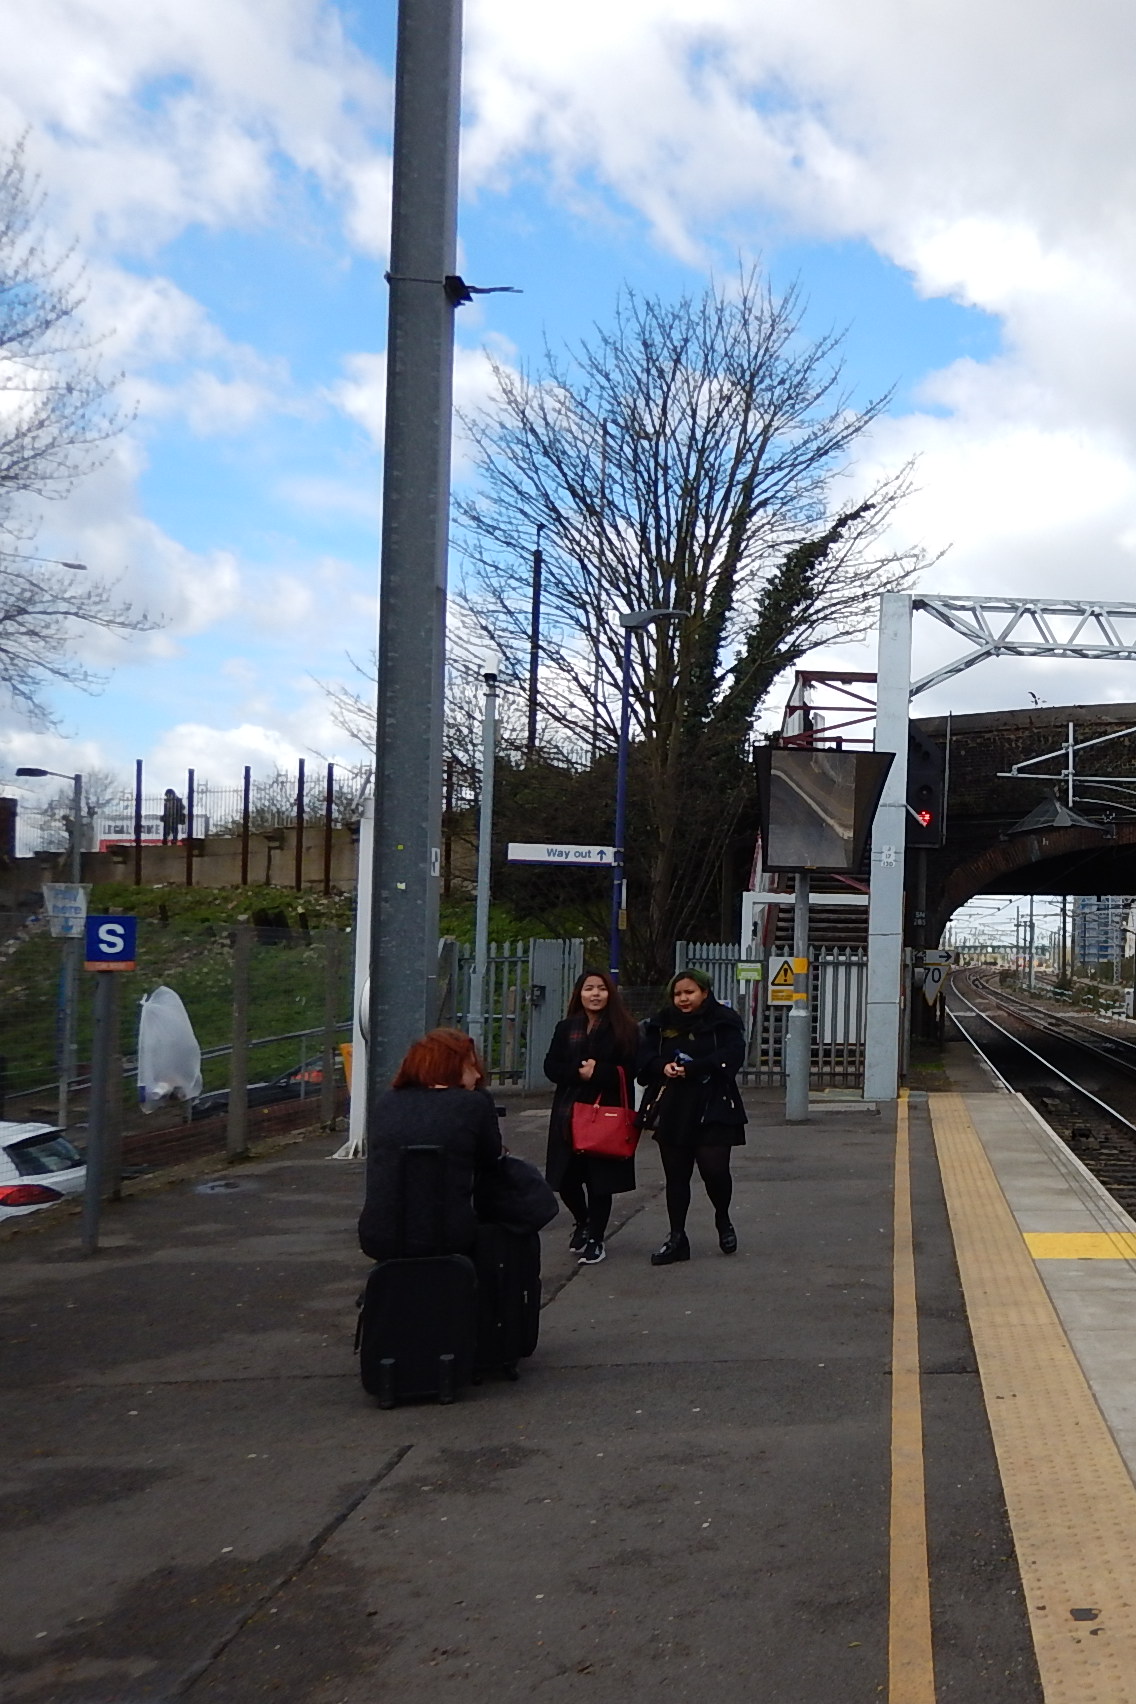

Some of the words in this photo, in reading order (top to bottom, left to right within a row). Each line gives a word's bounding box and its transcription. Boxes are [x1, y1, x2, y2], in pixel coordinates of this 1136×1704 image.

[546, 848, 570, 859] Way
[573, 849, 592, 859] out
[98, 923, 125, 954] S
[923, 967, 942, 984] 70
